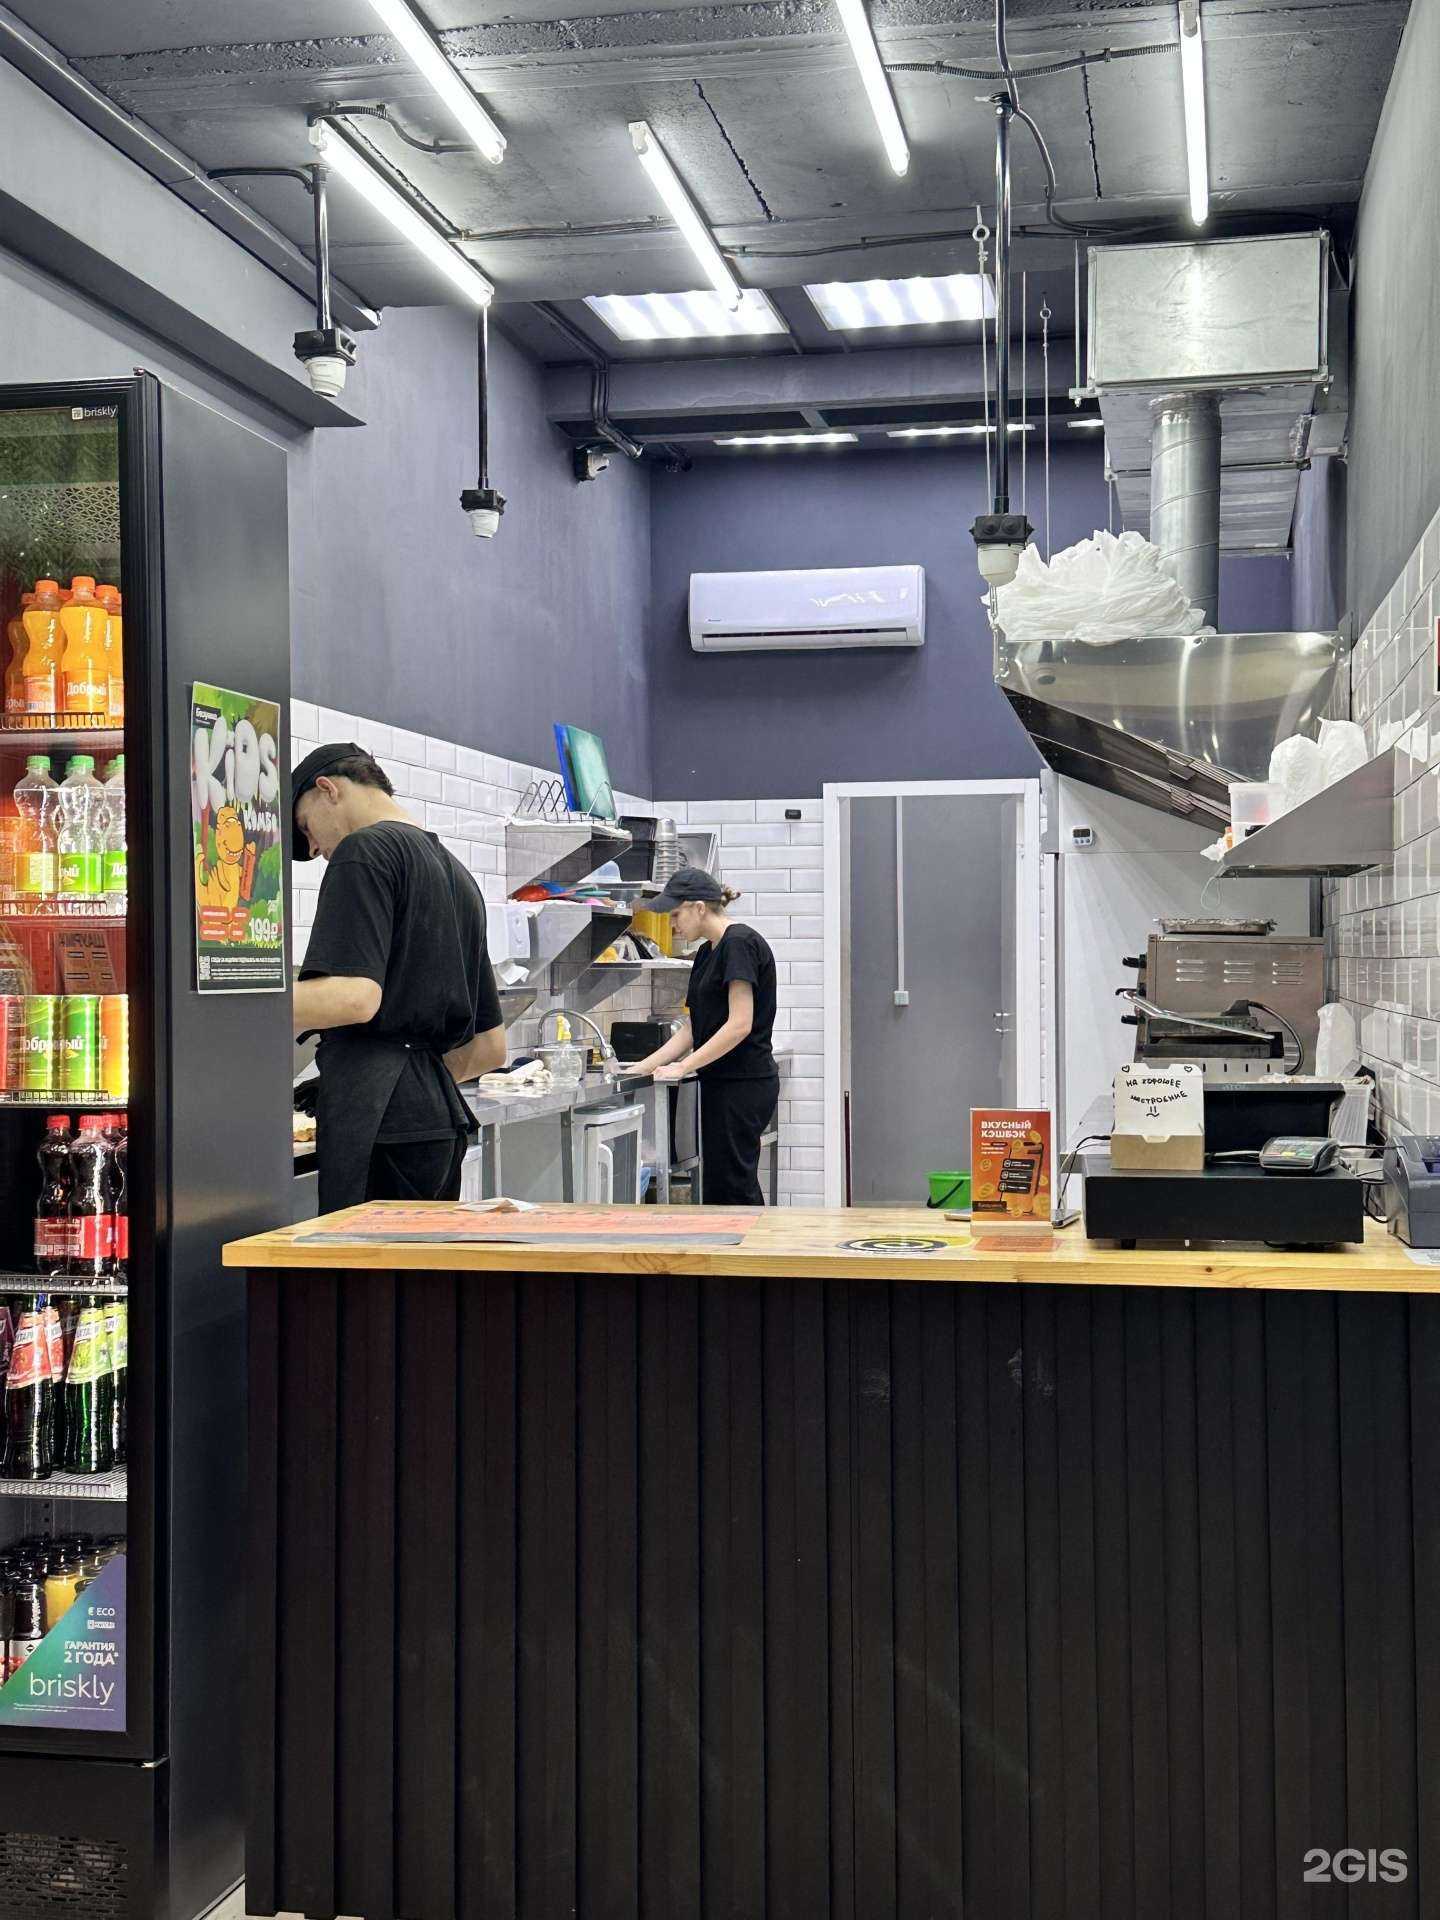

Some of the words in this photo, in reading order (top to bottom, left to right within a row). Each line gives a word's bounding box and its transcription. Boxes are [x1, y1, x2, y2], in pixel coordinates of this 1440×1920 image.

[84, 406, 117, 418] briskly
[981, 1120, 1032, 1129] ВКУСНЫЙ
[981, 1130, 1027, 1139] КЭШБЭК
[96, 1607, 116, 1617] ECO
[64, 1640, 116, 1651] ГАРАНТИЯ
[64, 1651, 72, 1664] 2
[30, 1672, 115, 1706] briskly
